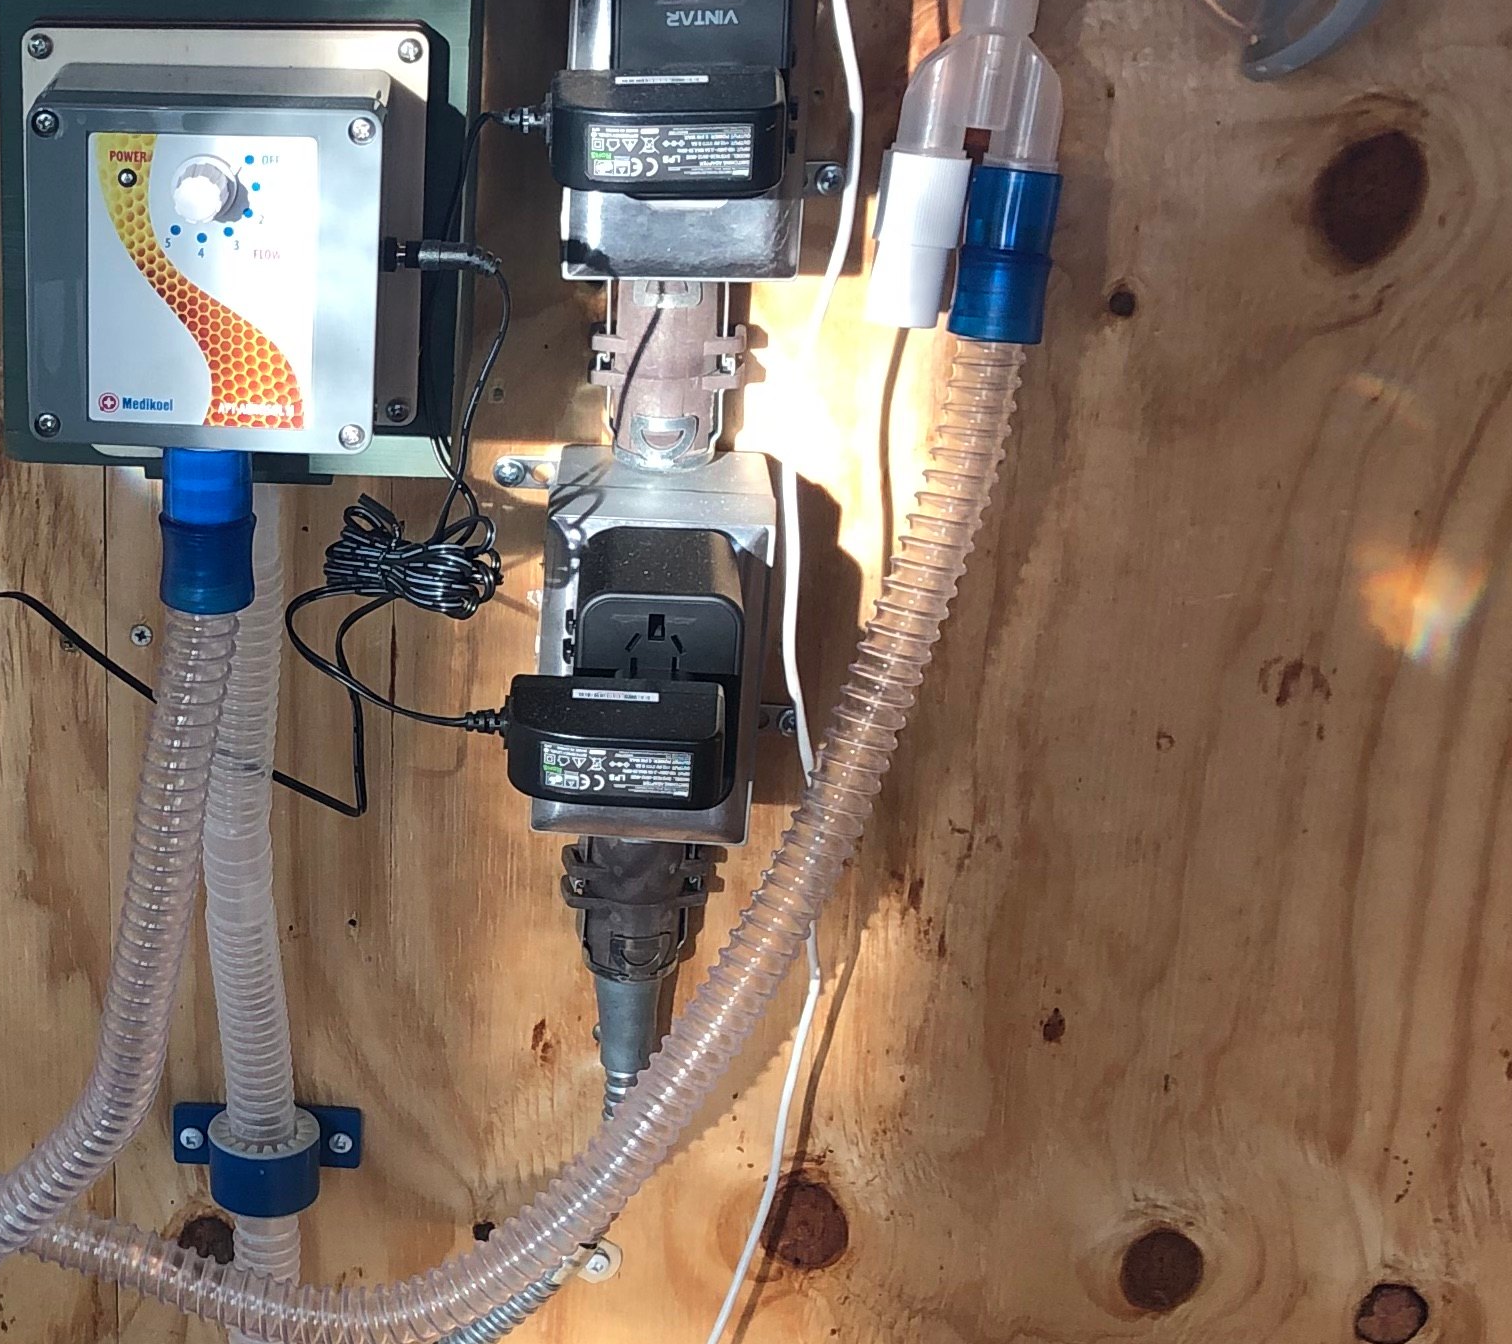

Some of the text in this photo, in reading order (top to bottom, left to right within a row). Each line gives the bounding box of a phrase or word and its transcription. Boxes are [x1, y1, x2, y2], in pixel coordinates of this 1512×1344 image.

[665, 8, 739, 27] VINTAR
[109, 150, 147, 163] POWER
[261, 155, 280, 165] OFF
[165, 237, 171, 248] 5
[233, 240, 240, 251] 3
[197, 247, 205, 258] 4
[253, 249, 281, 260] FLOW
[122, 396, 174, 412] Medikoel
